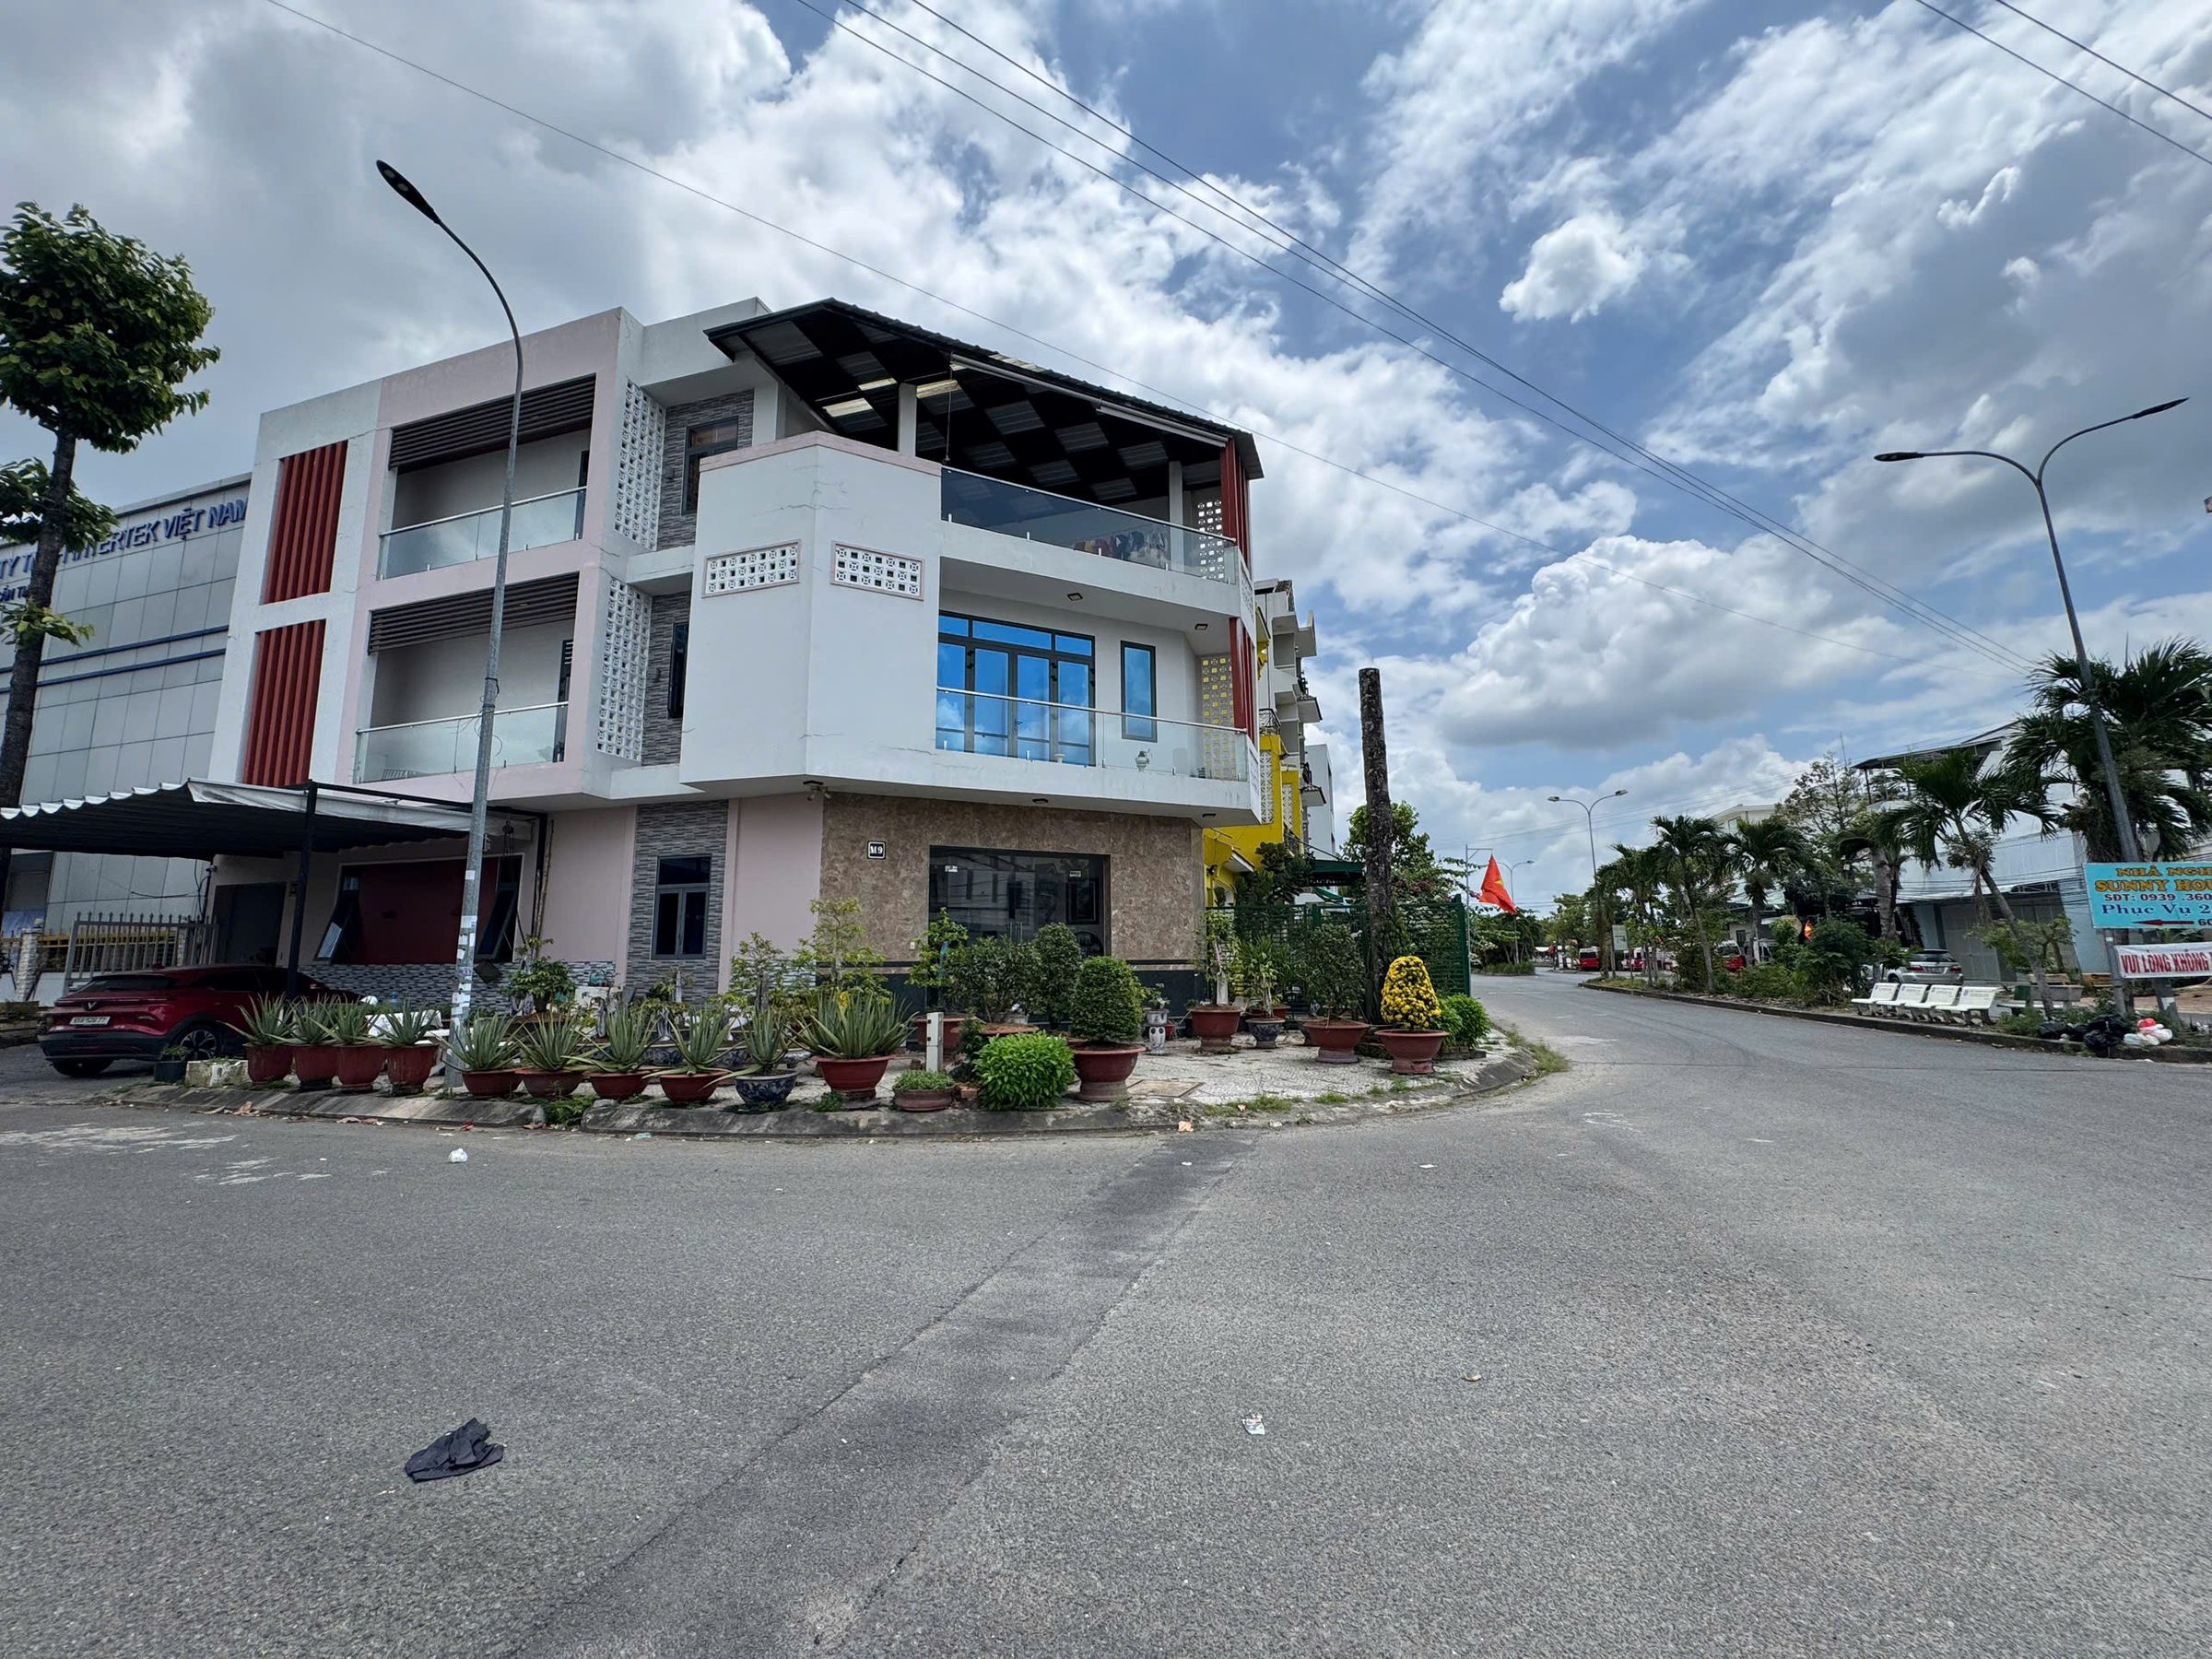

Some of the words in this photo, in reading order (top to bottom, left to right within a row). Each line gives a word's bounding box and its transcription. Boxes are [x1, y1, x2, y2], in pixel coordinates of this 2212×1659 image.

[72, 521, 160, 561] ERTEK
[163, 508, 206, 541] VIỆT
[207, 498, 248, 528] NAM
[2116, 865, 2162, 877] NHÀ
[2094, 879, 2170, 892] SUNNY
[2140, 893, 2176, 901] 0939
[2101, 904, 2154, 916] Phục
[2161, 904, 2192, 916] Vụ
[2121, 954, 2140, 973] VUI
[2142, 949, 2171, 973] LÒNG
[2171, 949, 2209, 972] KHÔNG
